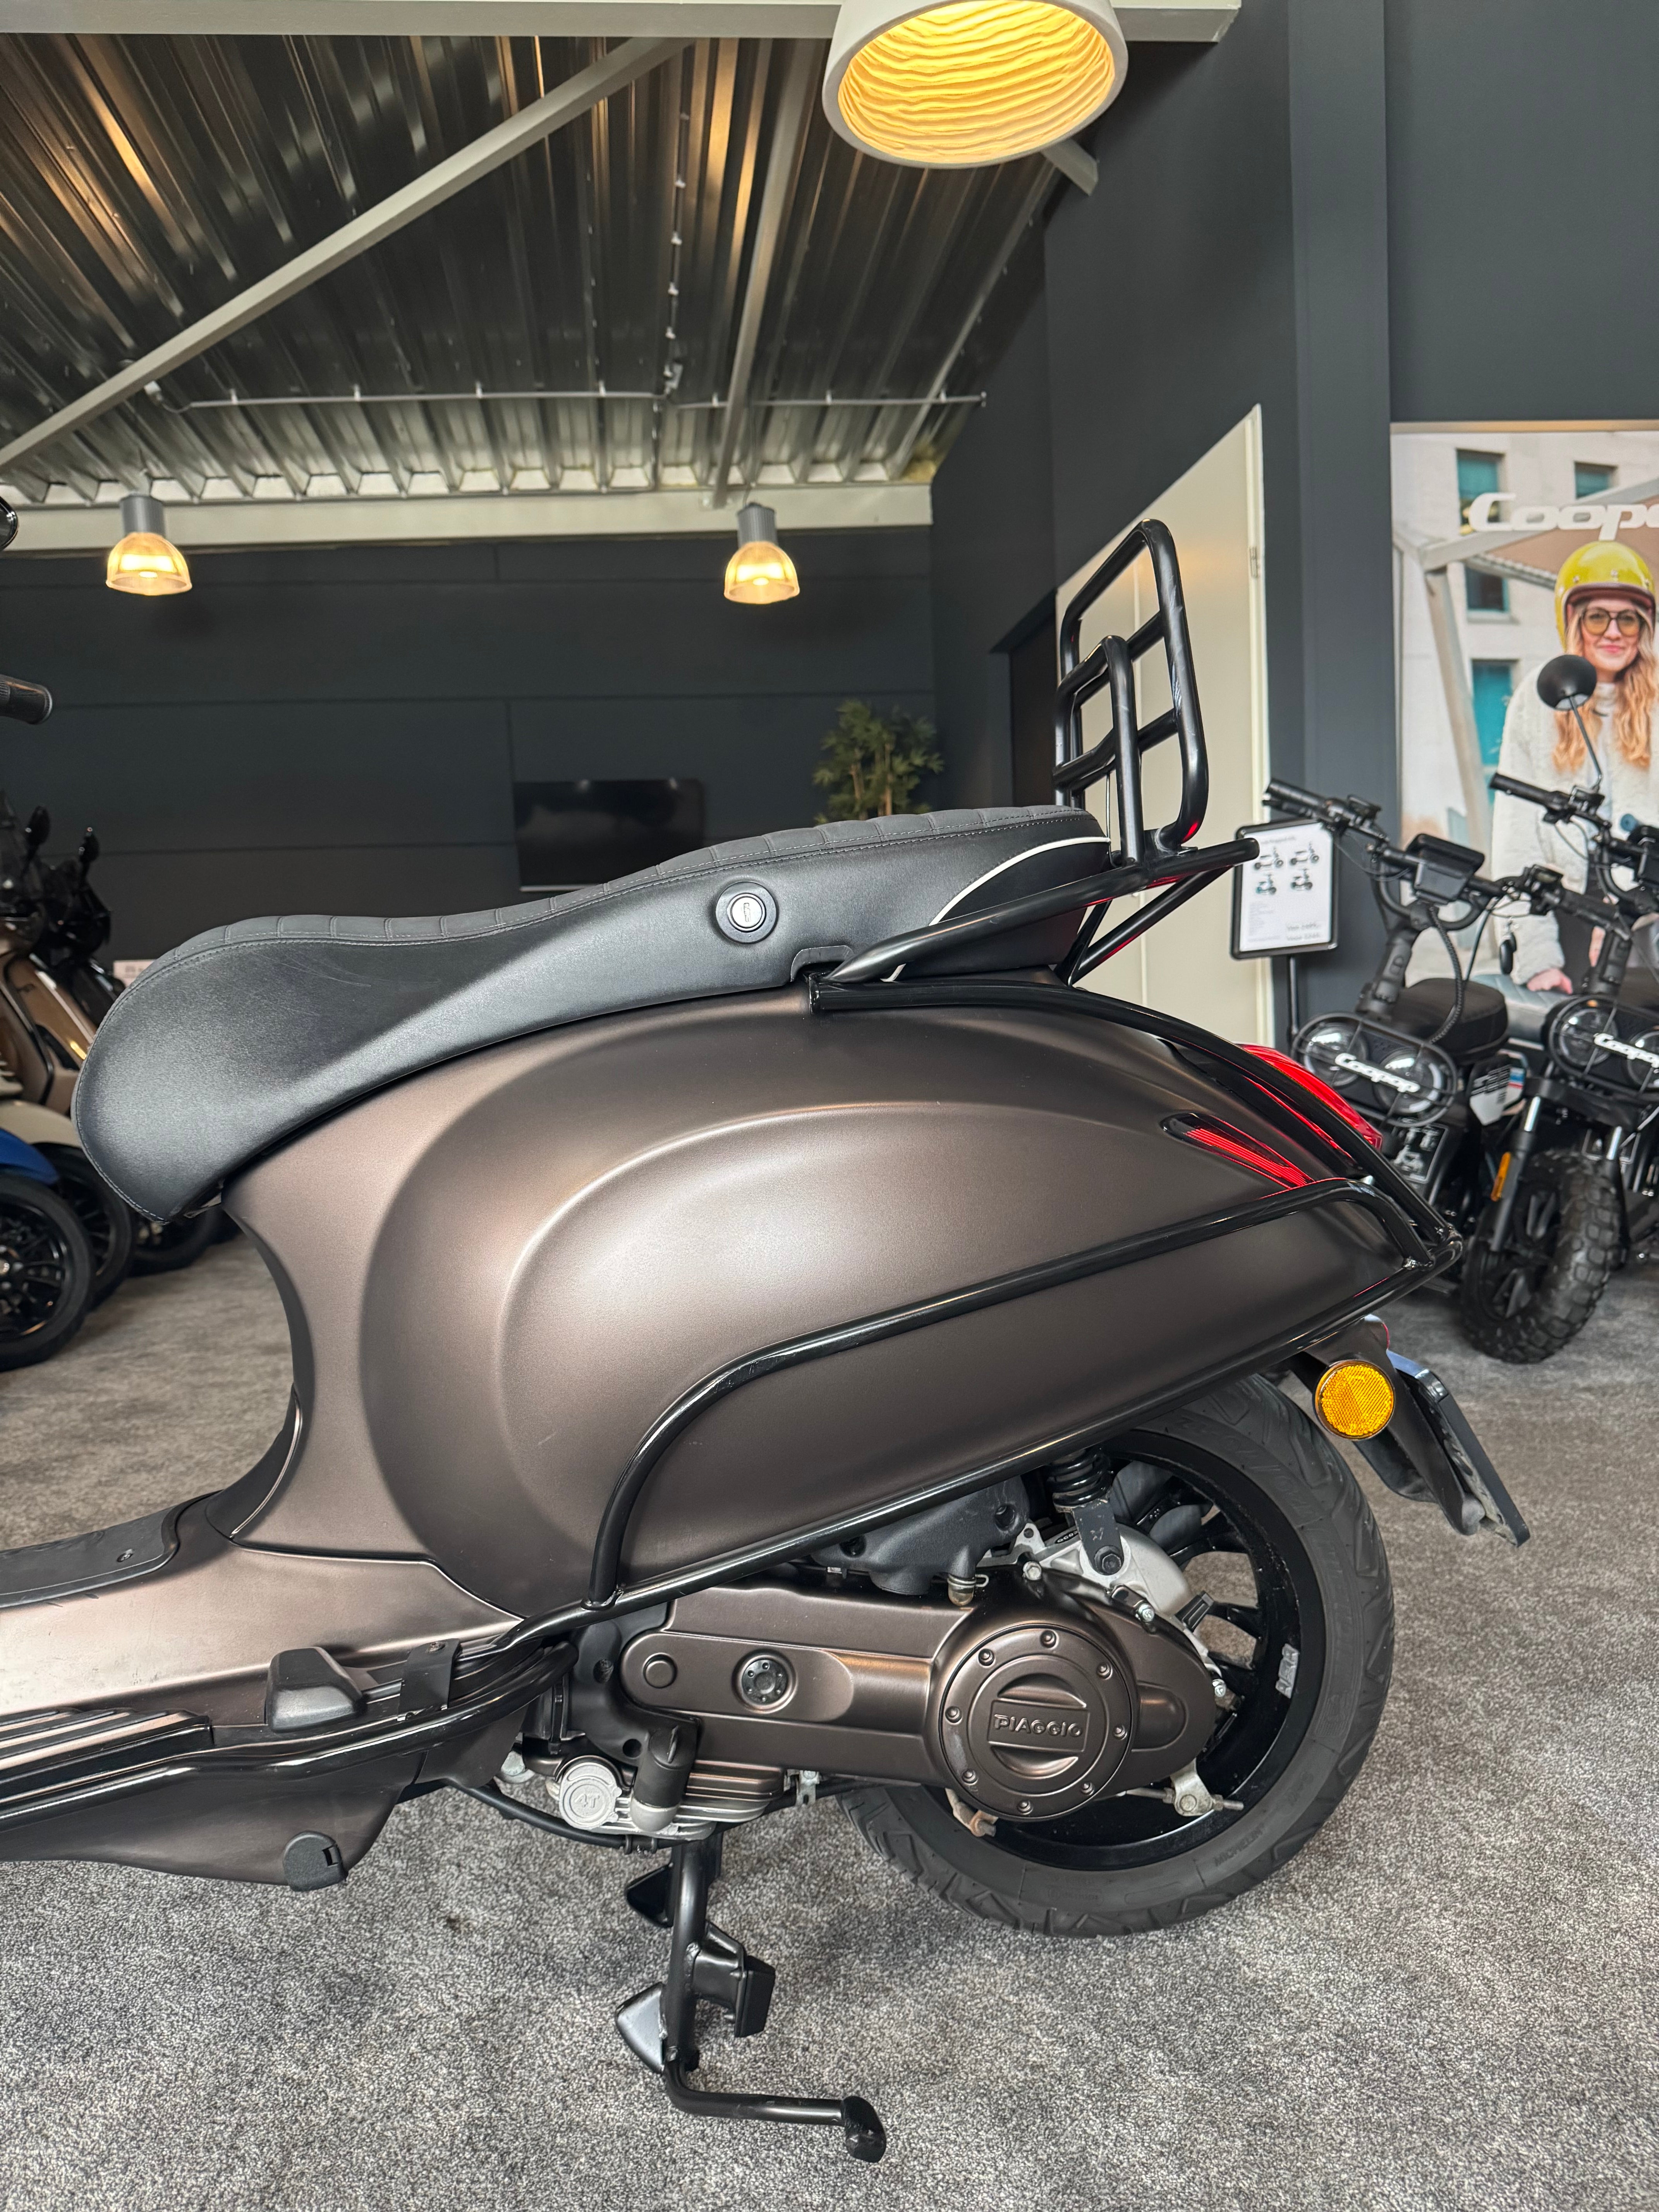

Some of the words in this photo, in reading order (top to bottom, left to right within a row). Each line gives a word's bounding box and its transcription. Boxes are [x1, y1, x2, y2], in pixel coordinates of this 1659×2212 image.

[1334, 1053, 1421, 1092] Coopop
[994, 1714, 1082, 1737] PIAGGIO
[574, 1793, 600, 1809] 4T
